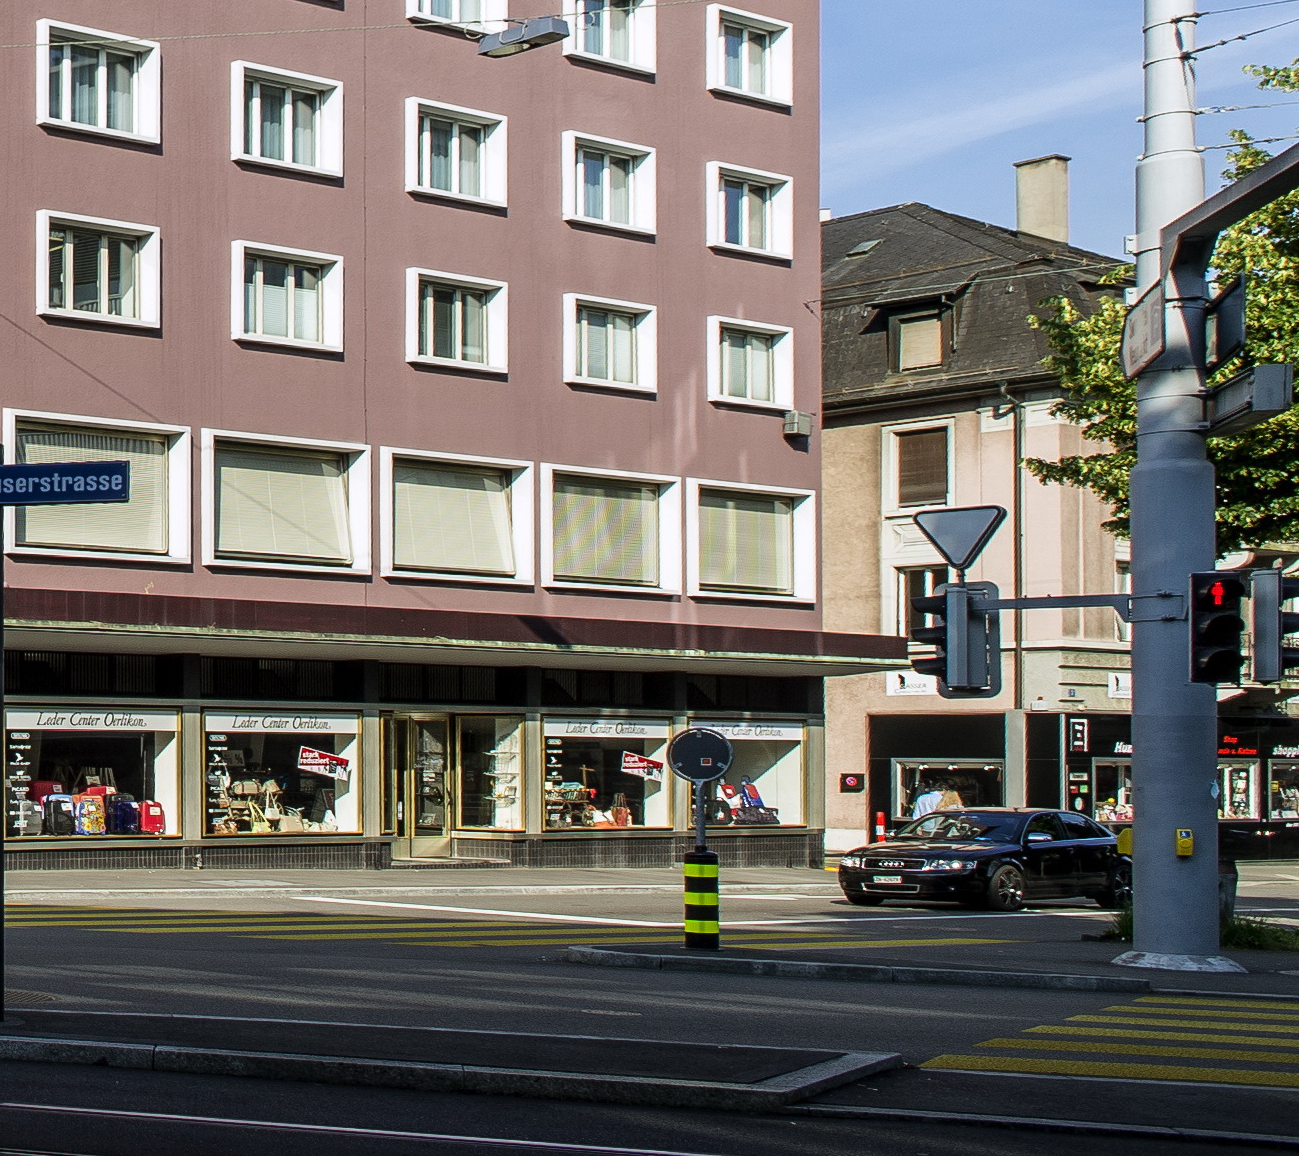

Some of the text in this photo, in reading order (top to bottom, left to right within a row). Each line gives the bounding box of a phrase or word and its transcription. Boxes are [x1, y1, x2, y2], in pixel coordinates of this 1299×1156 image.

[36, 711, 66, 726] Leder
[70, 711, 101, 726] Center
[232, 715, 259, 729] Leder
[261, 715, 289, 729] Center
